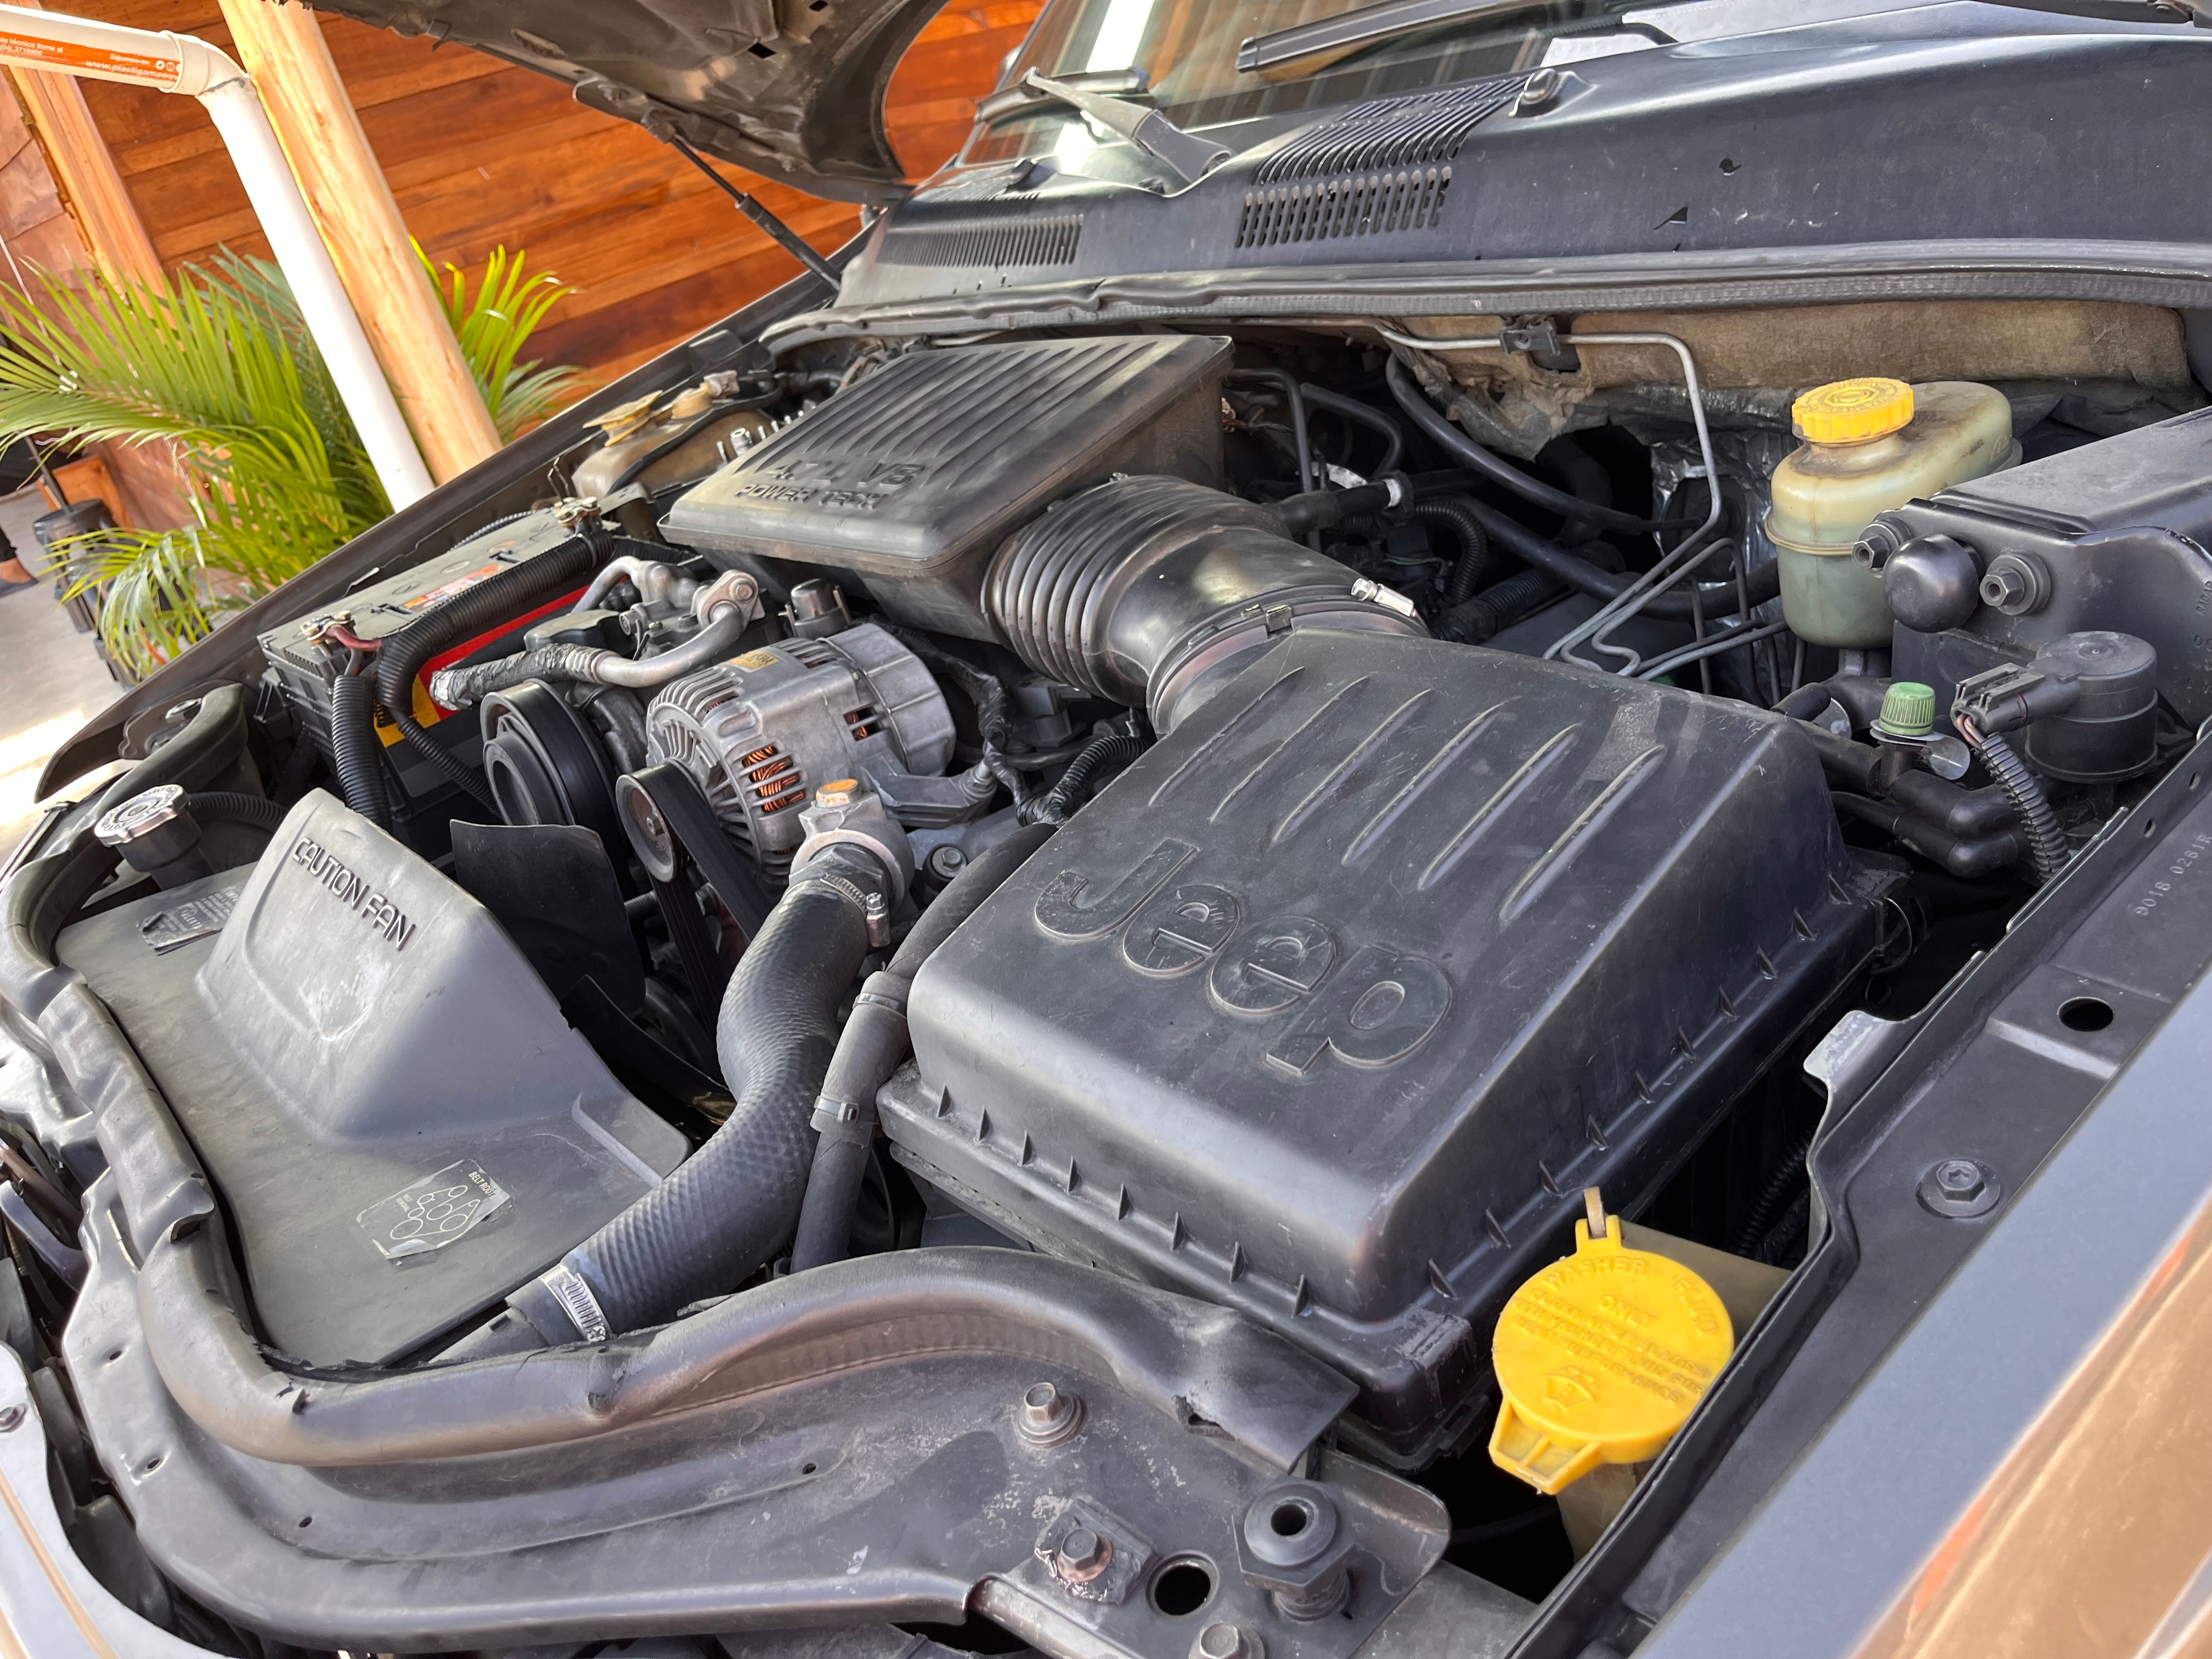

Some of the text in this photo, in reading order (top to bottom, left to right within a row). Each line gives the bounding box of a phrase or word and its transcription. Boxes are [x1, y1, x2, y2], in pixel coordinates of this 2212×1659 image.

[37, 42, 55, 52] llame
[857, 462, 926, 489] V8
[735, 484, 891, 510] POWER TECH
[293, 837, 370, 910] CAUTION
[361, 893, 416, 951] FAN
[1034, 837, 1453, 1077] Jeep
[469, 1171, 486, 1187] BELT
[1541, 1256, 1647, 1291] WASHER
[1597, 1294, 1660, 1329] ONLY
[1671, 1278, 1717, 1336] FLUID
